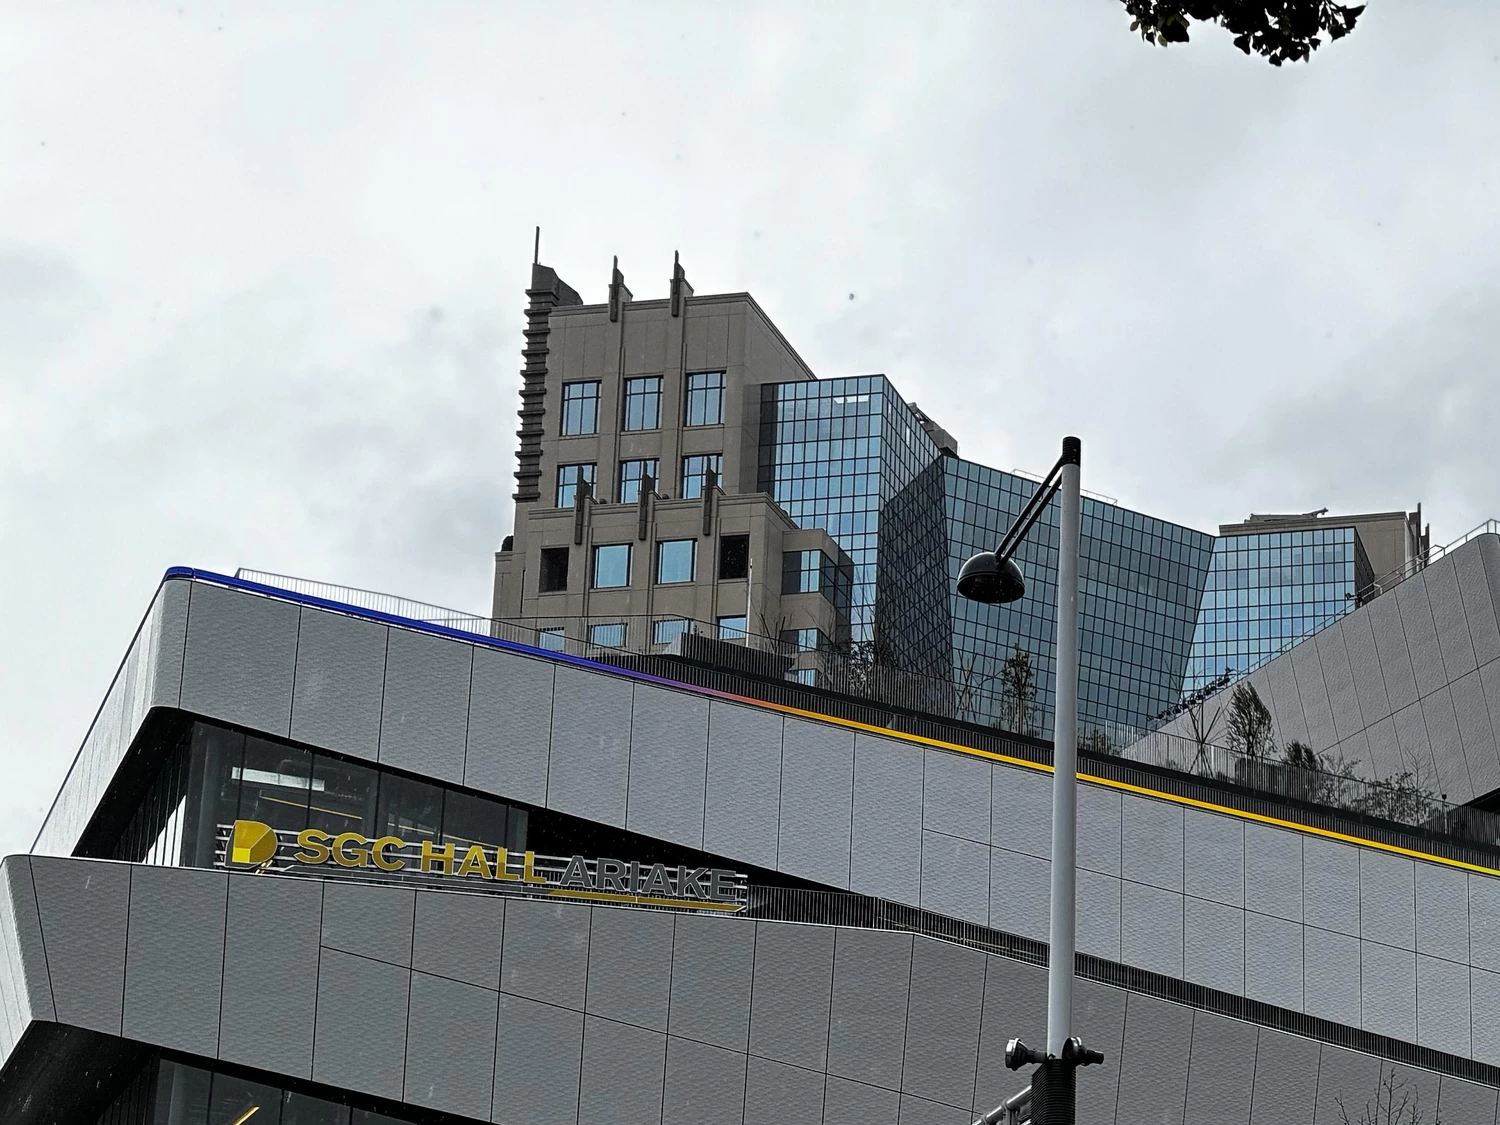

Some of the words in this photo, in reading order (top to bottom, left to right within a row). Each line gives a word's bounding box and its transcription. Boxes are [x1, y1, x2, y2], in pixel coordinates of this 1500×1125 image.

[294, 828, 406, 872] SGC
[421, 840, 546, 884] HALL
[559, 854, 738, 901] ARIAKE
